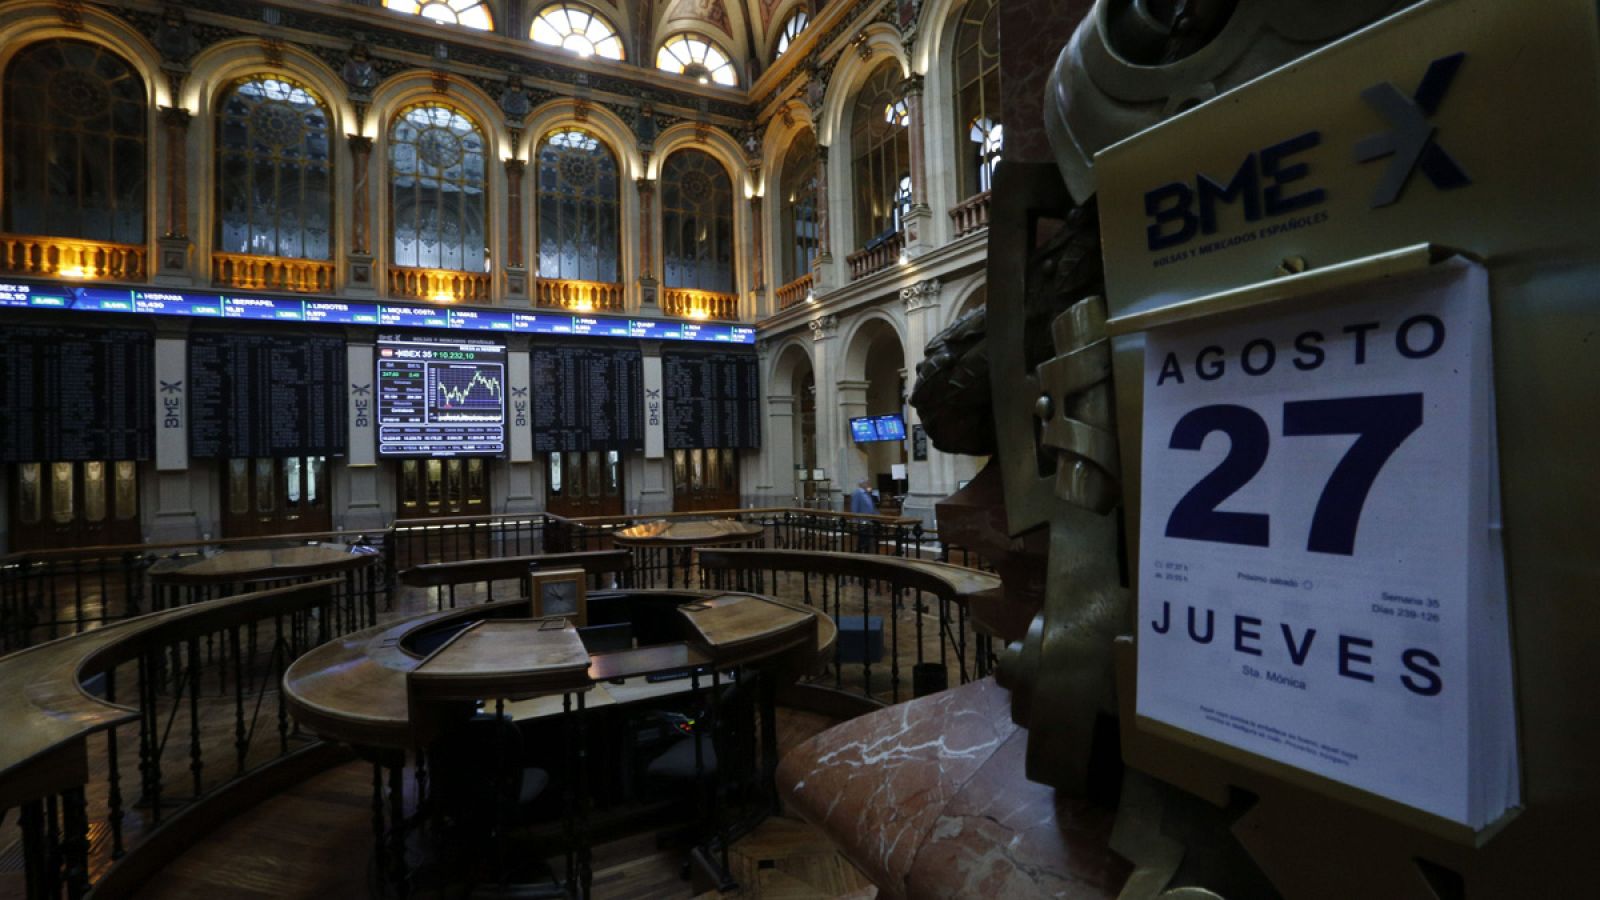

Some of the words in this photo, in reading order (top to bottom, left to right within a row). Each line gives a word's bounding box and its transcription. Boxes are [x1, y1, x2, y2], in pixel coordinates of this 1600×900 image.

[1144, 130, 1327, 252] BME
[1152, 250, 1189, 268] BOLSAS
[1188, 247, 1197, 257] Y
[1199, 232, 1257, 257] MERCADOS
[1259, 210, 1329, 239] ESPAÑOLES
[1156, 313, 1445, 387] AGOSTO
[164, 397, 179, 428] BME
[355, 399, 368, 428] BME
[515, 400, 526, 426] BME
[649, 401, 659, 426] BME
[1164, 392, 1424, 557] 27
[1381, 592, 1423, 606] Semana
[1426, 598, 1440, 608] 35
[1151, 600, 1443, 697] JUEVES
[1241, 664, 1263, 680] Sta.
[1265, 670, 1307, 690] Mónica
